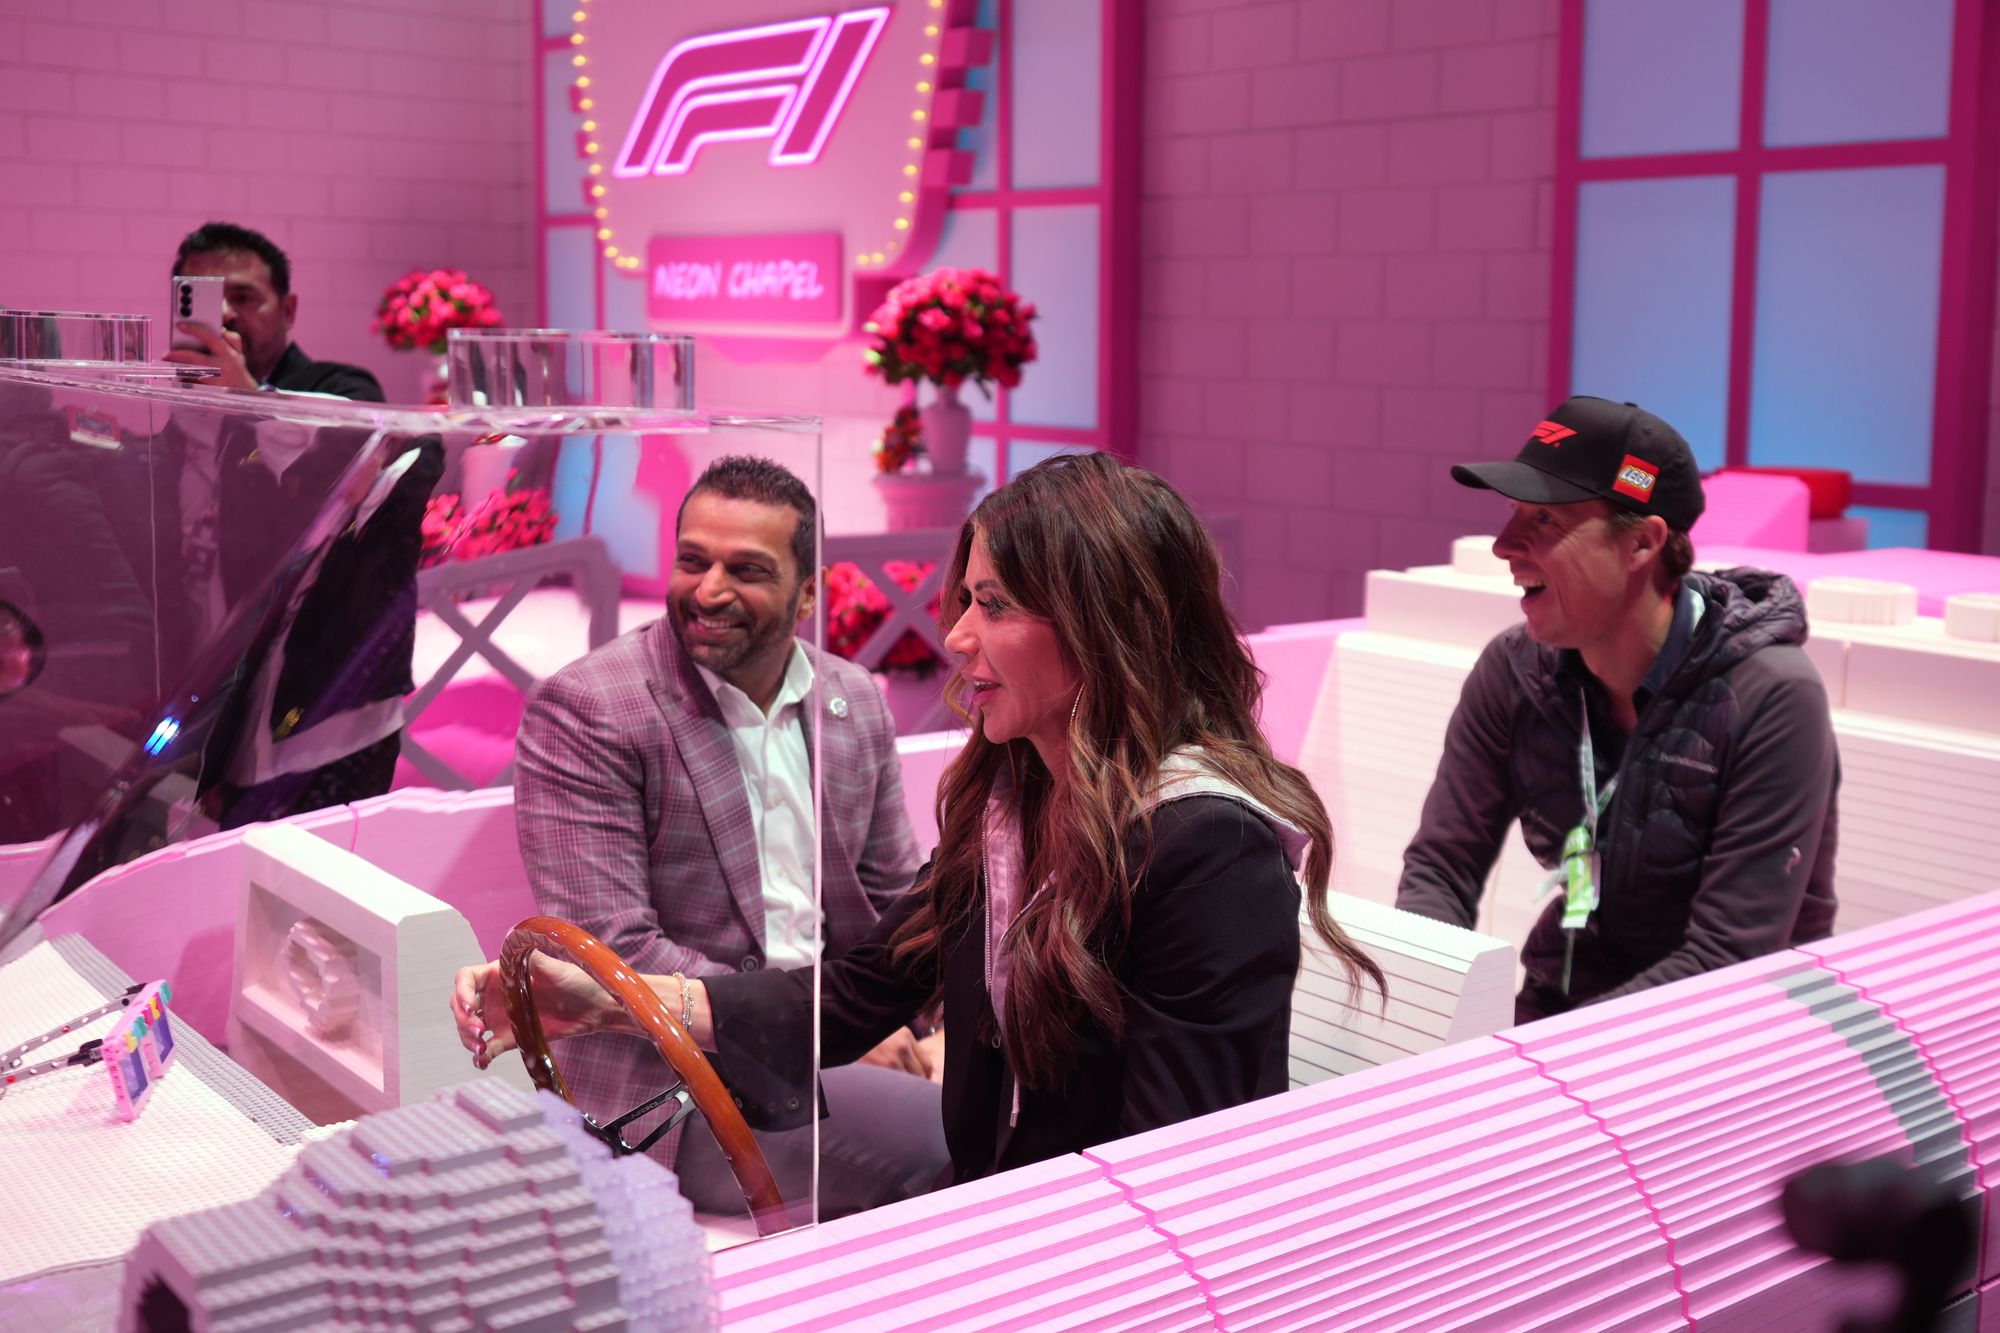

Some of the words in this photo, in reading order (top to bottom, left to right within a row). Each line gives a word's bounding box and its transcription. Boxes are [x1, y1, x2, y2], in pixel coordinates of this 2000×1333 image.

[654, 261, 722, 300] NEON
[728, 259, 825, 300] CHAPEL
[1619, 465, 1656, 490] LEGO
